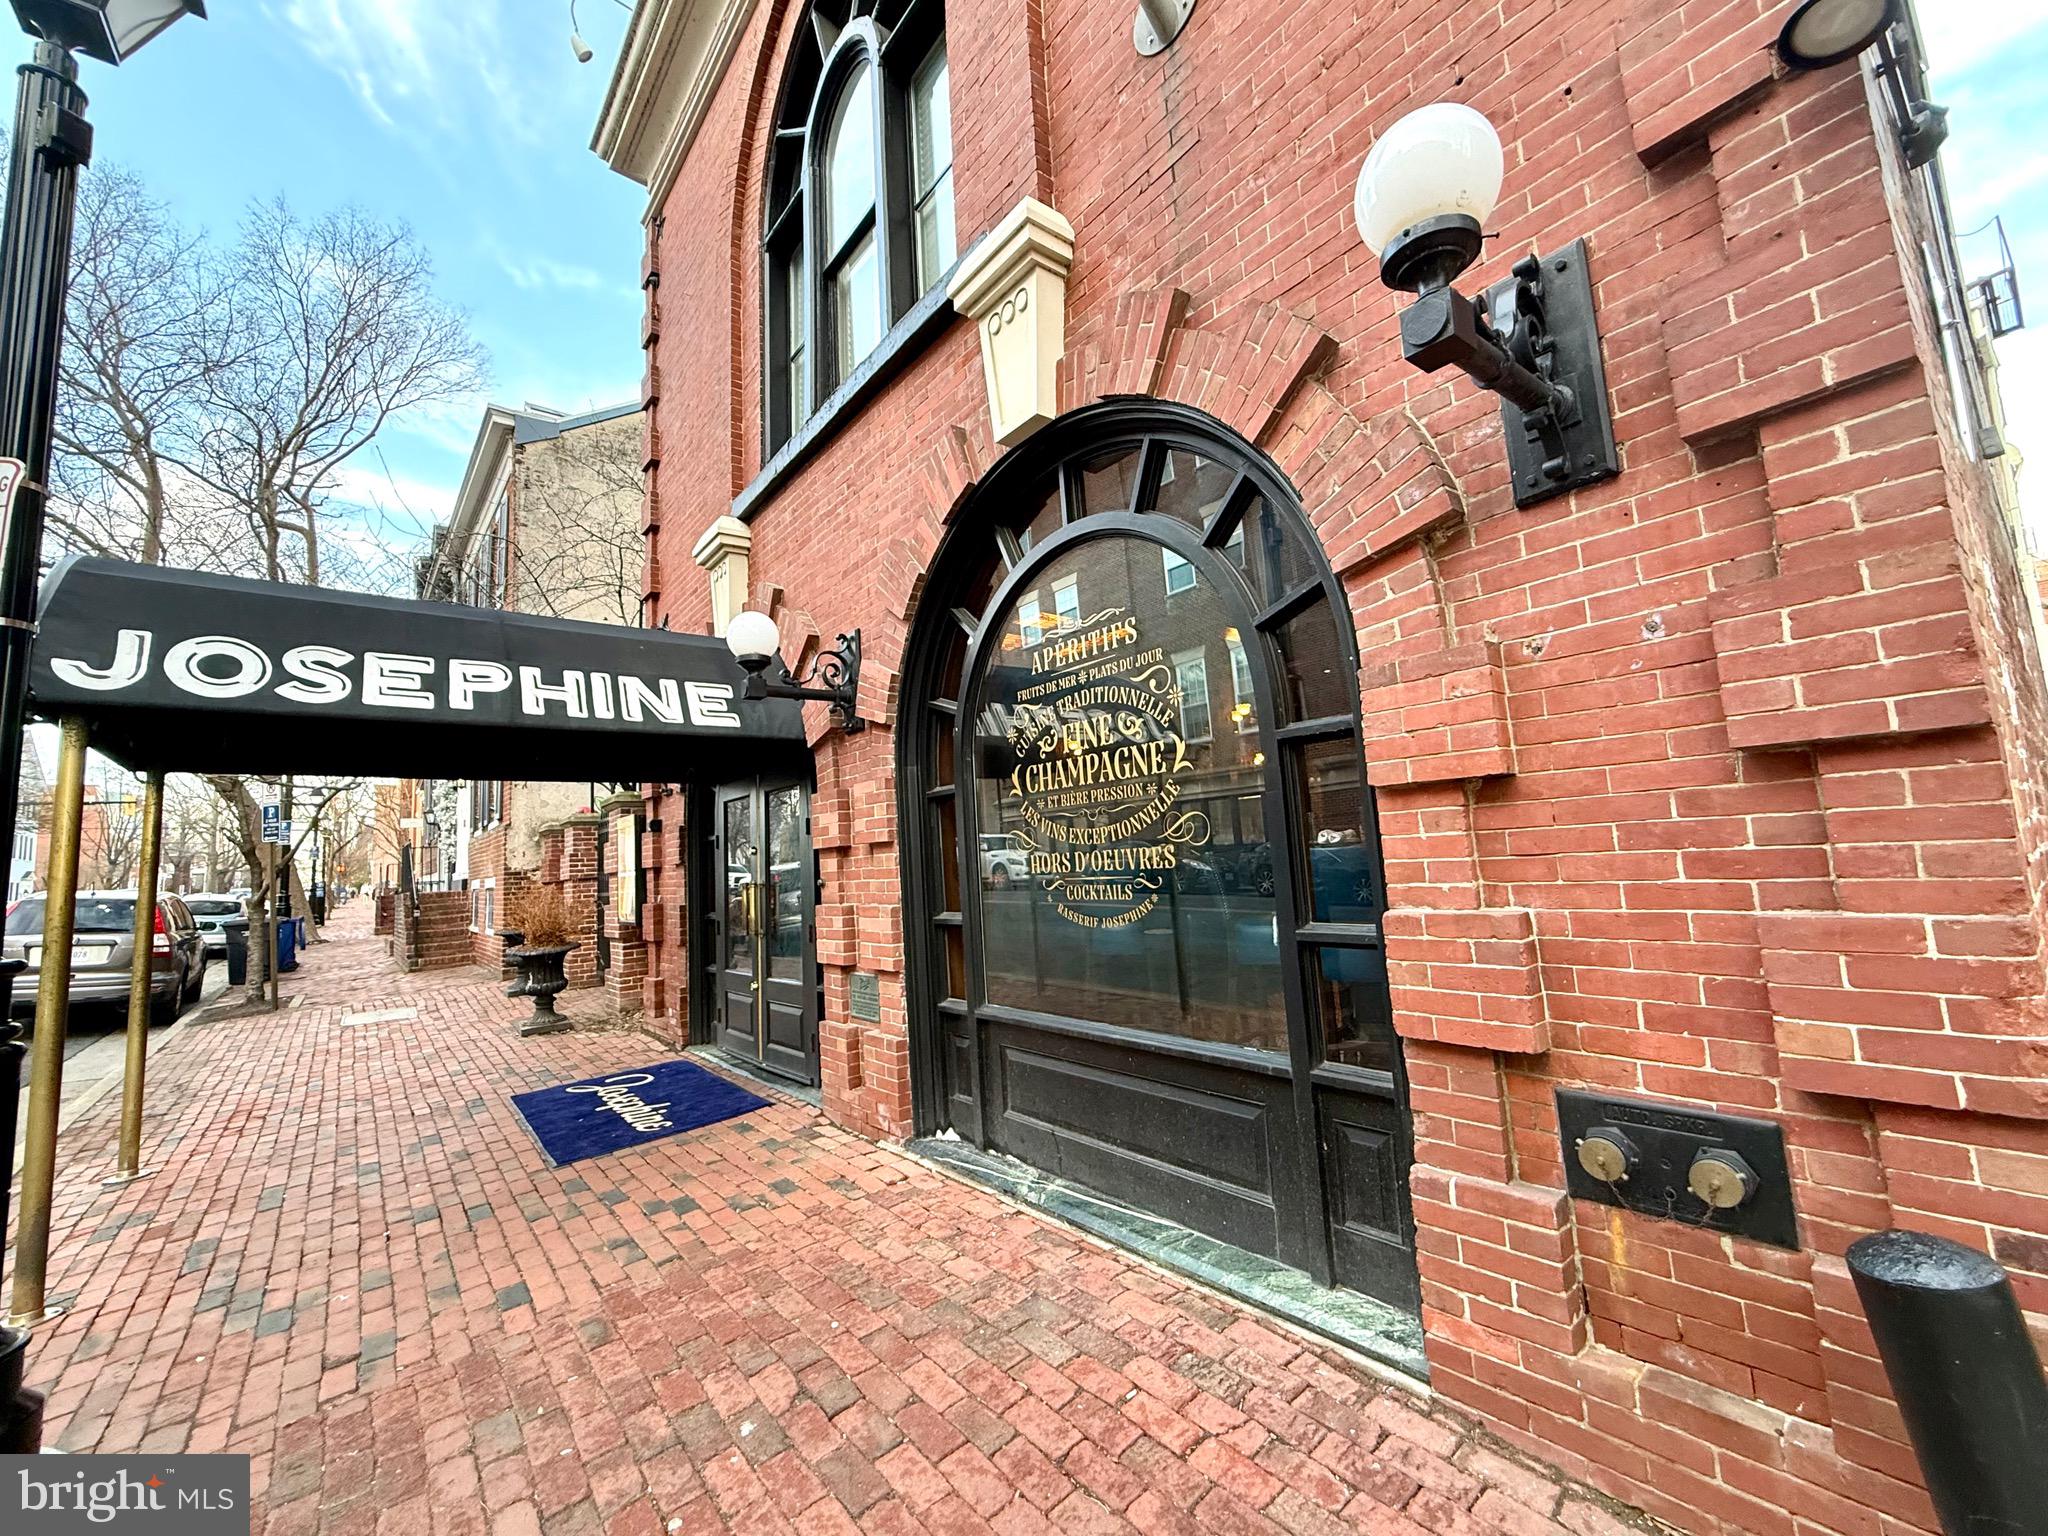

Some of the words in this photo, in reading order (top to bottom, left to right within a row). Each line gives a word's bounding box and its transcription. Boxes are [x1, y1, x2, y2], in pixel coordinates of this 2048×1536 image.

[1031, 616, 1138, 675] APÉRITIFS
[50, 628, 742, 728] JOSEPHINE
[1017, 684, 1046, 702] FRUITS
[1046, 681, 1057, 693] DE
[1059, 674, 1077, 691] MER
[1089, 661, 1118, 682] PLATS
[1119, 657, 1134, 671] DU
[1135, 647, 1164, 667] JOUR
[1015, 705, 1056, 758] CUISINE
[1056, 685, 1174, 728] TRADITIONNELLE
[1062, 713, 1114, 754] FINE
[1025, 740, 1167, 794] CHAMPAGNE
[1020, 800, 1040, 828] LES
[1040, 819, 1067, 842] VINS
[1069, 779, 1181, 845] EXCEPTIONNELLE
[1047, 797, 1058, 808] ET
[1061, 792, 1088, 807] BIÈRE
[1091, 783, 1144, 803] PRESSION
[1031, 851, 1071, 874] HORS
[1074, 843, 1176, 873] D'OEUVRES
[1066, 884, 1133, 900] COCKTAILS
[1101, 898, 1154, 929] JOSEPHINE
